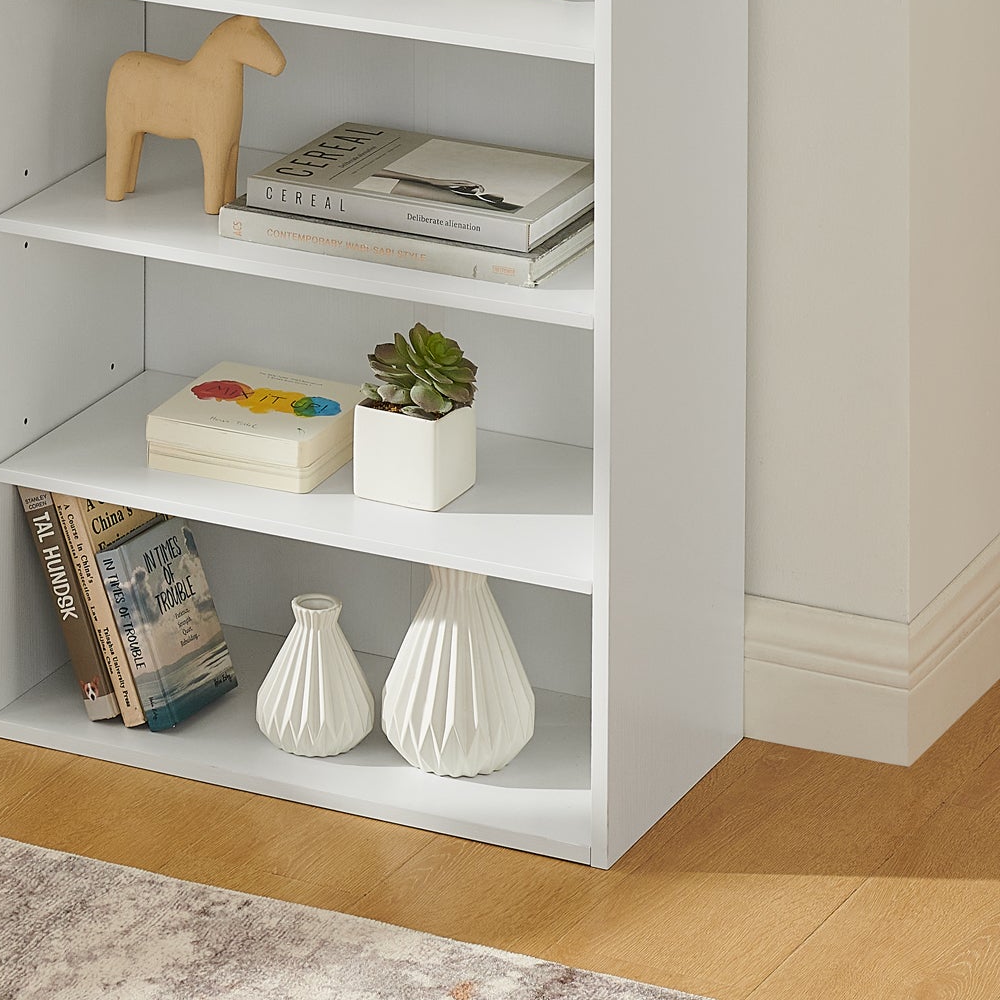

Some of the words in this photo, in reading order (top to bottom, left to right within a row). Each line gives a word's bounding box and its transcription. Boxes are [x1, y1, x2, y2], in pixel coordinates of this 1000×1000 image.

[276, 129, 385, 177] CEREAL
[266, 186, 346, 212] CEREAL
[407, 213, 444, 226] Deliberate
[444, 219, 481, 232] alienation
[266, 228, 343, 248] CONTEMPORARY
[25, 494, 47, 505] STANLEY
[28, 501, 47, 510] COREN
[86, 499, 96, 513] A
[33, 511, 55, 543] TAL
[92, 505, 134, 535] China's
[57, 505, 79, 559] Environmental
[76, 563, 92, 602] Protection
[90, 605, 98, 622] Law
[67, 513, 79, 540] Course
[80, 555, 94, 584] China's
[143, 549, 157, 574] IN
[154, 535, 182, 567] TIMES
[103, 558, 116, 571] IN
[162, 562, 175, 586] OF
[42, 545, 79, 621] HUNDSK
[108, 573, 126, 604] TIMES
[155, 575, 197, 615] TROUBLE
[118, 606, 132, 620] OF
[123, 622, 147, 670] TROUBLE
[106, 656, 114, 675] China
[112, 656, 126, 689] University
[122, 690, 131, 708] Press
